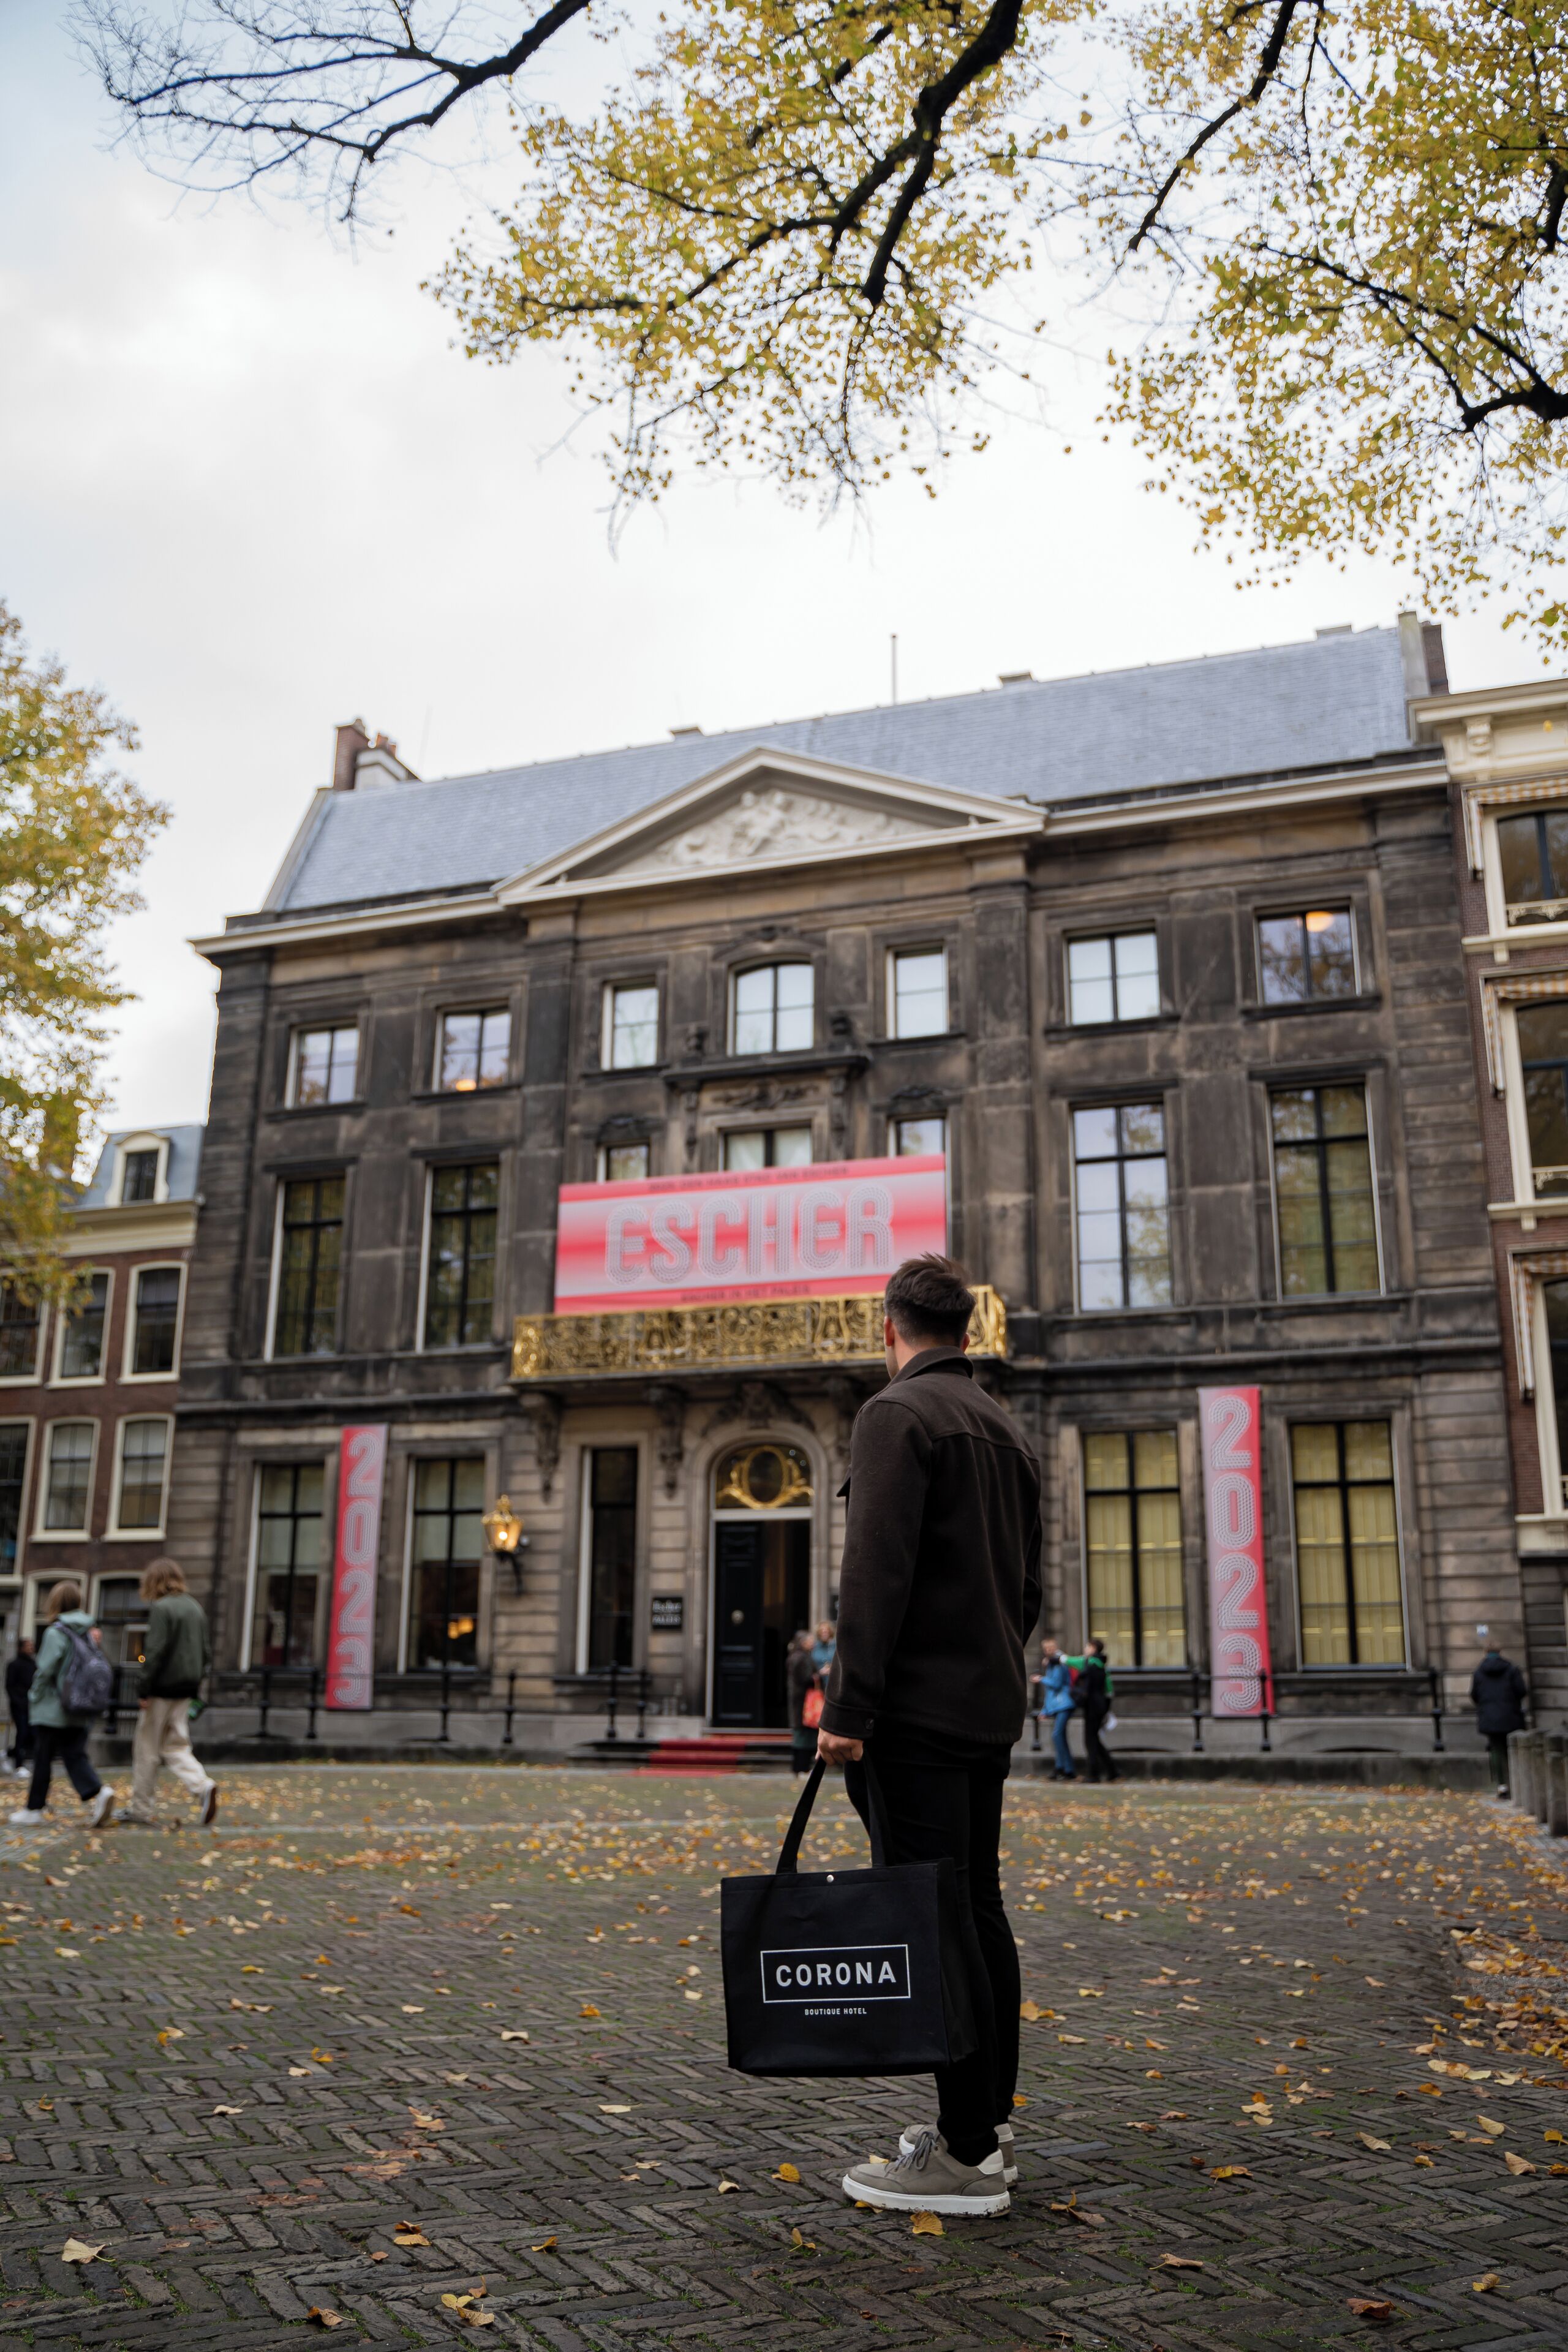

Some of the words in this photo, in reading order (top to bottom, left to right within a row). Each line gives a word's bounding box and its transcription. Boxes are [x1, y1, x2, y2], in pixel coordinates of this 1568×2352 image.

[606, 1185, 893, 1286] ESCHER
[333, 1431, 380, 1705] 2023
[1208, 1395, 1262, 1711] 2023
[776, 1961, 896, 1987] CORONA
